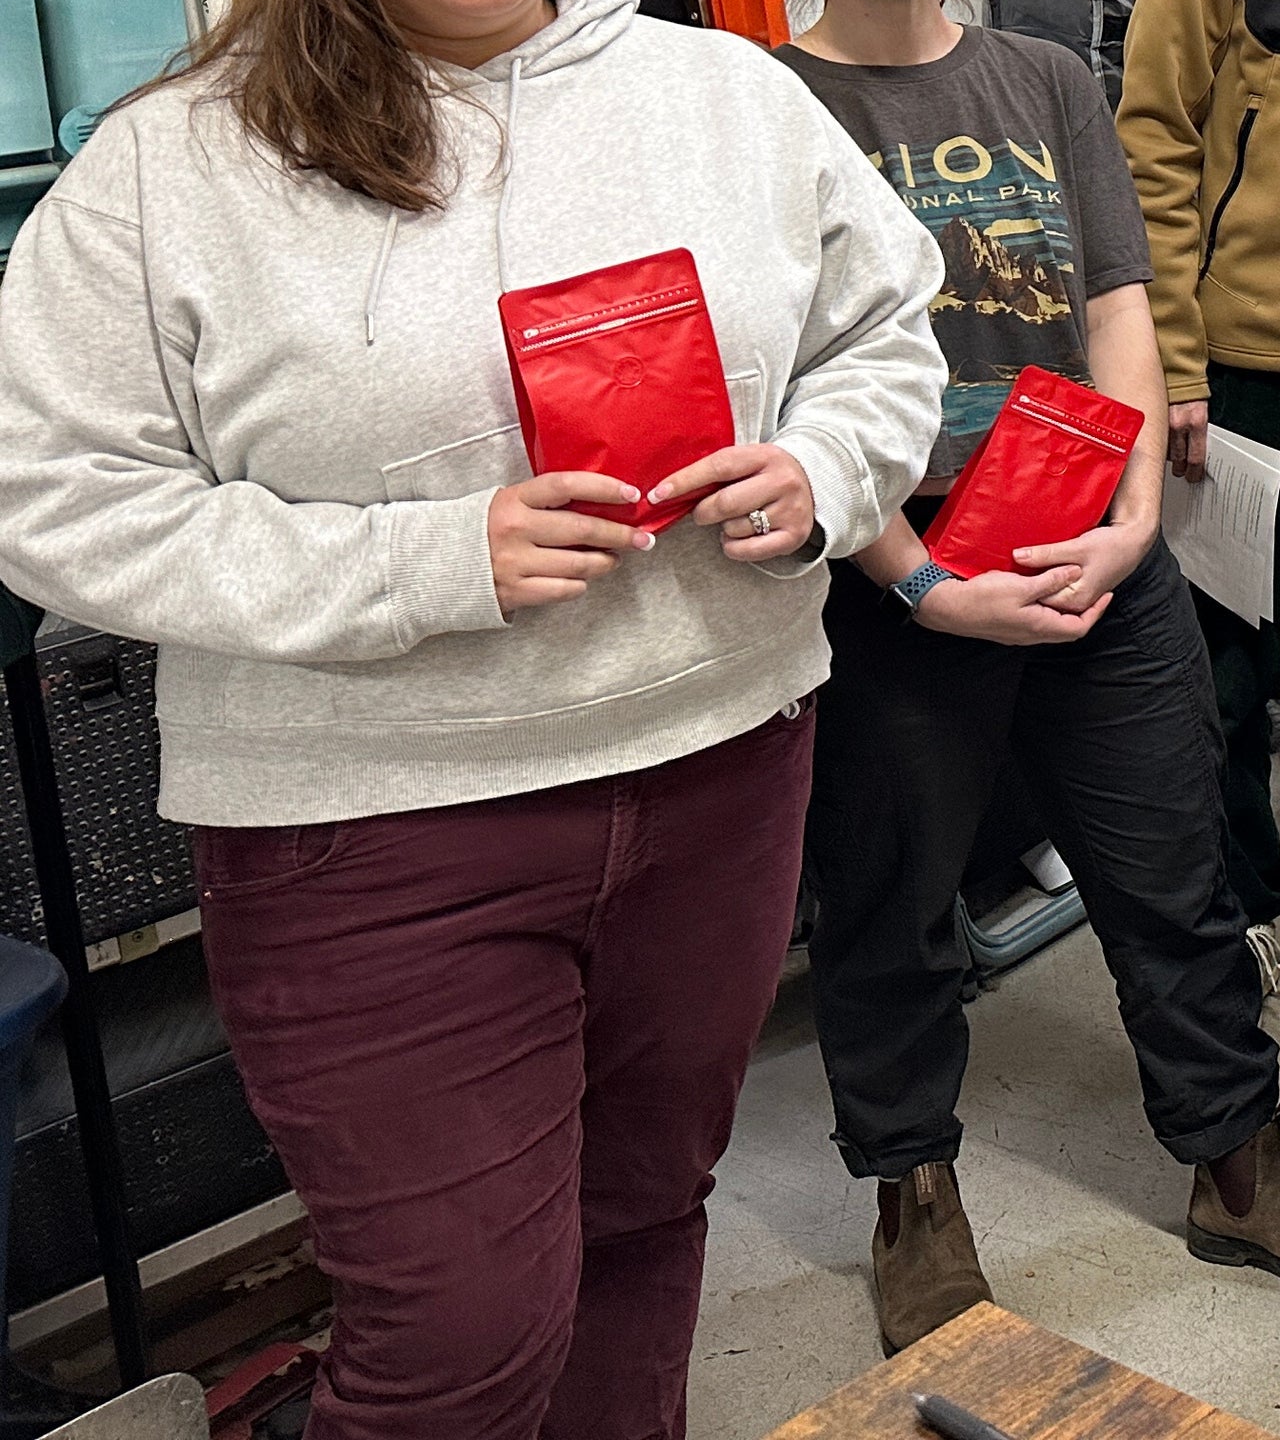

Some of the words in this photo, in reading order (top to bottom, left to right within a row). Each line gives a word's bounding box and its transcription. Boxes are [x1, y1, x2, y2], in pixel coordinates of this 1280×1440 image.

[868, 135, 1057, 189] ION
[904, 190, 985, 211] ONAL
[998, 183, 1062, 206] PARK
